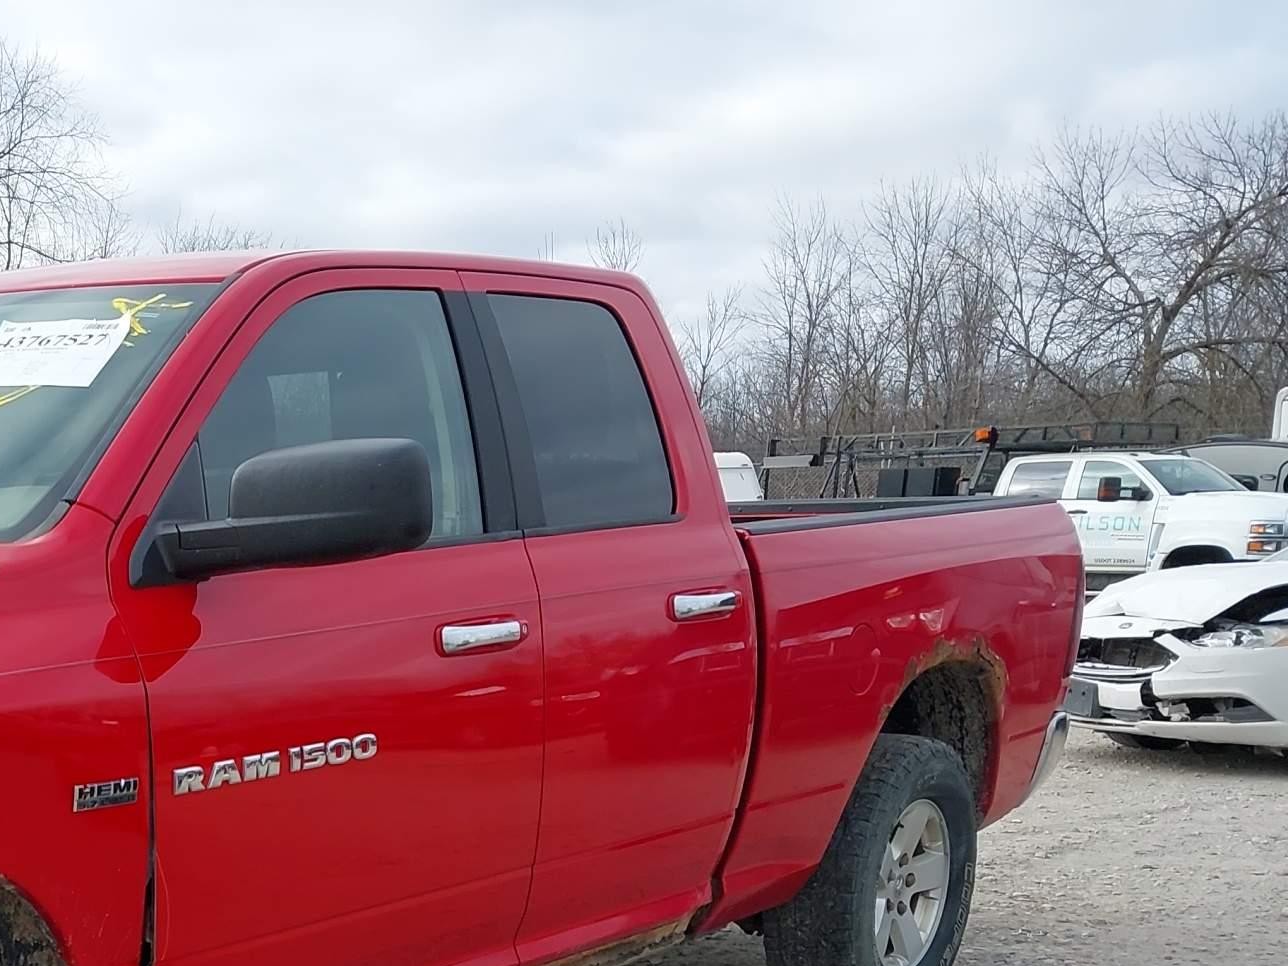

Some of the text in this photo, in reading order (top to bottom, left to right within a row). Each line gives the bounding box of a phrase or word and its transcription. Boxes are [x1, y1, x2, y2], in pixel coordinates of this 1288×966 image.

[0, 333, 109, 348] 43767527
[1079, 515, 1142, 531] ILSON
[173, 733, 378, 796] RAM 1500
[76, 779, 139, 799] HEMI
